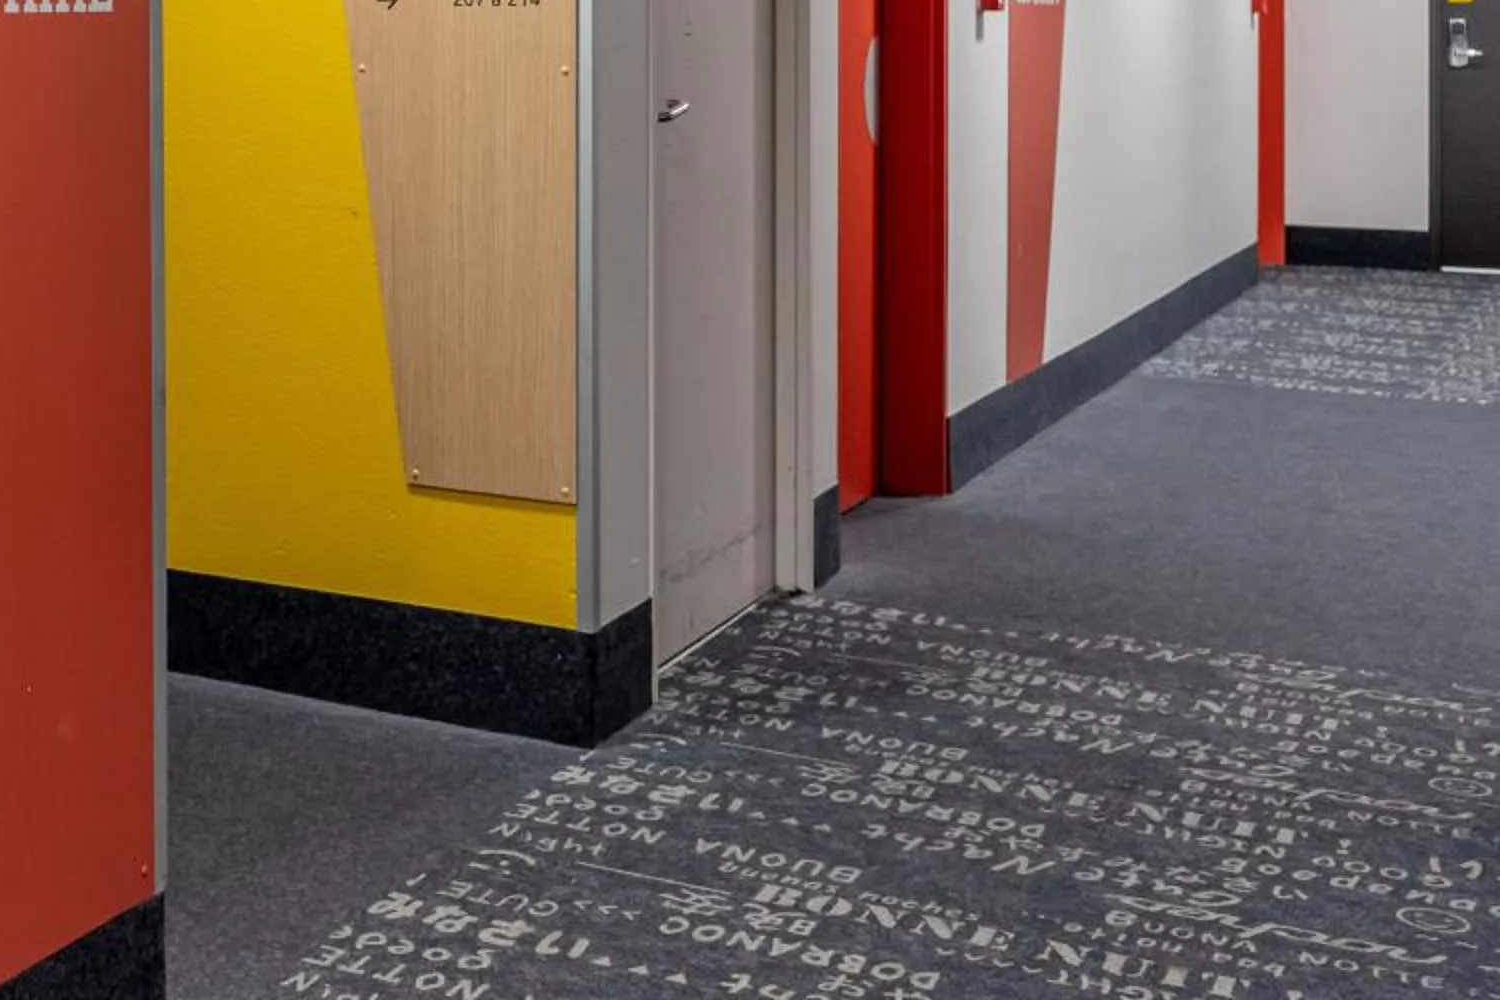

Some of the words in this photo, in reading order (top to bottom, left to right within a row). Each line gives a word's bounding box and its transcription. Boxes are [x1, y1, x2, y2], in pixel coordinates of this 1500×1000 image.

[821, 726, 968, 760] BUONA
[880, 760, 1104, 810] BONNE
[504, 804, 665, 844] NOTTE
[801, 783, 1044, 837] DOBRANOC
[696, 838, 862, 883] BUONA
[861, 824, 1056, 874] Nacht
[1312, 856, 1452, 887] GOOD
[436, 880, 559, 916] GUTE
[659, 917, 940, 990] DOBRANOC
[754, 884, 1015, 951] BONNE
[1037, 940, 1250, 997] NUIT
[302, 945, 490, 1000] NOTTE
[1047, 972, 1171, 1000] IGHT
